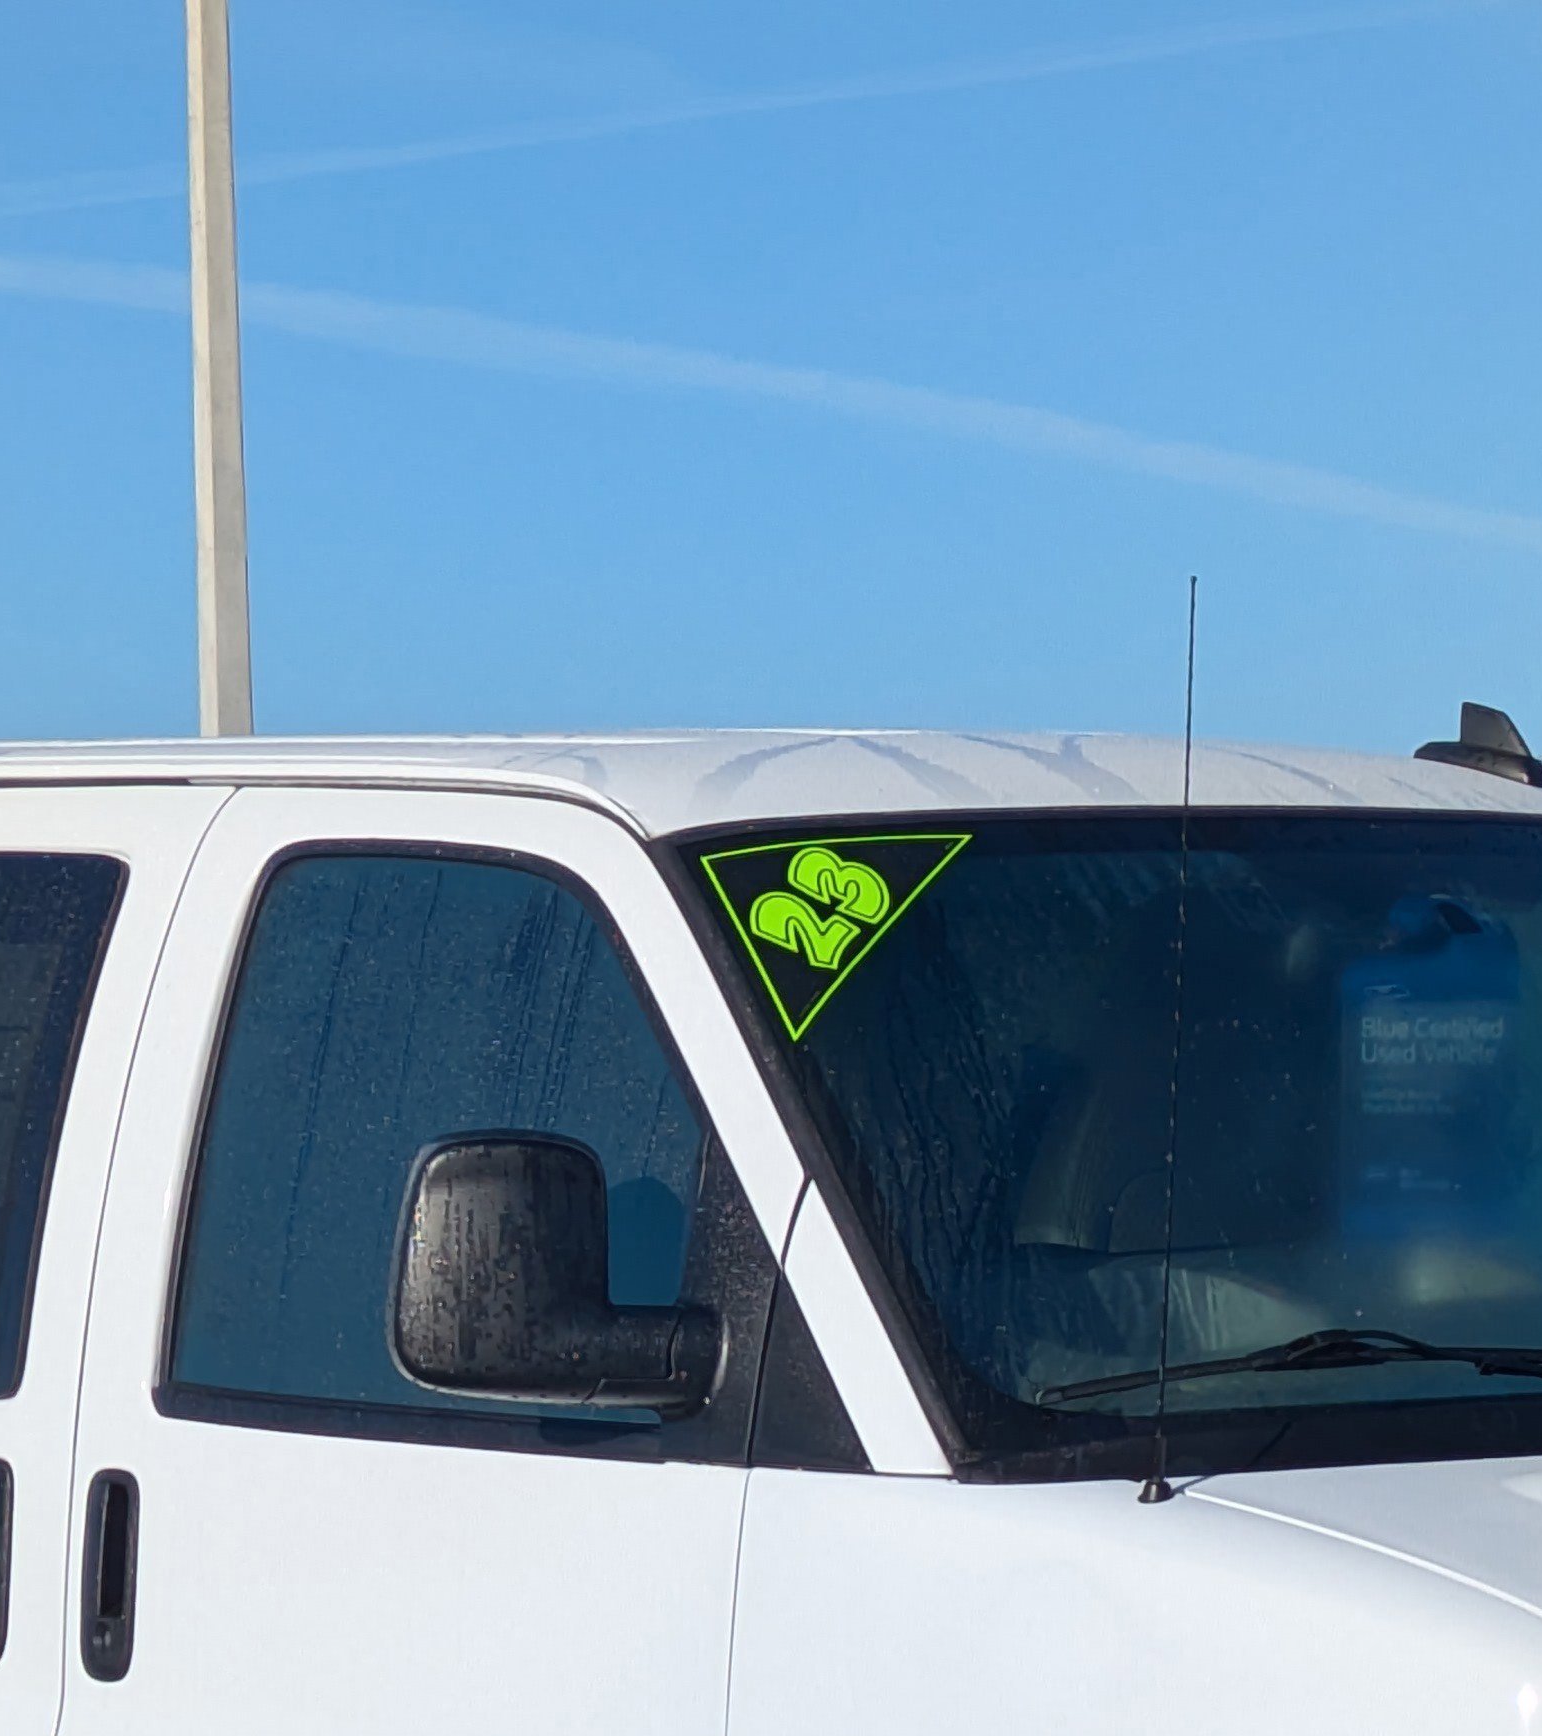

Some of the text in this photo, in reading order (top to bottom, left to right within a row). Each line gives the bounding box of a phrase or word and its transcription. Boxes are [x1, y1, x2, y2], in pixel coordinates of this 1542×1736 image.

[750, 847, 890, 970] 23
[1360, 1017, 1504, 1039] Blue Certified
[1360, 1042, 1498, 1064] Used Vehicle
